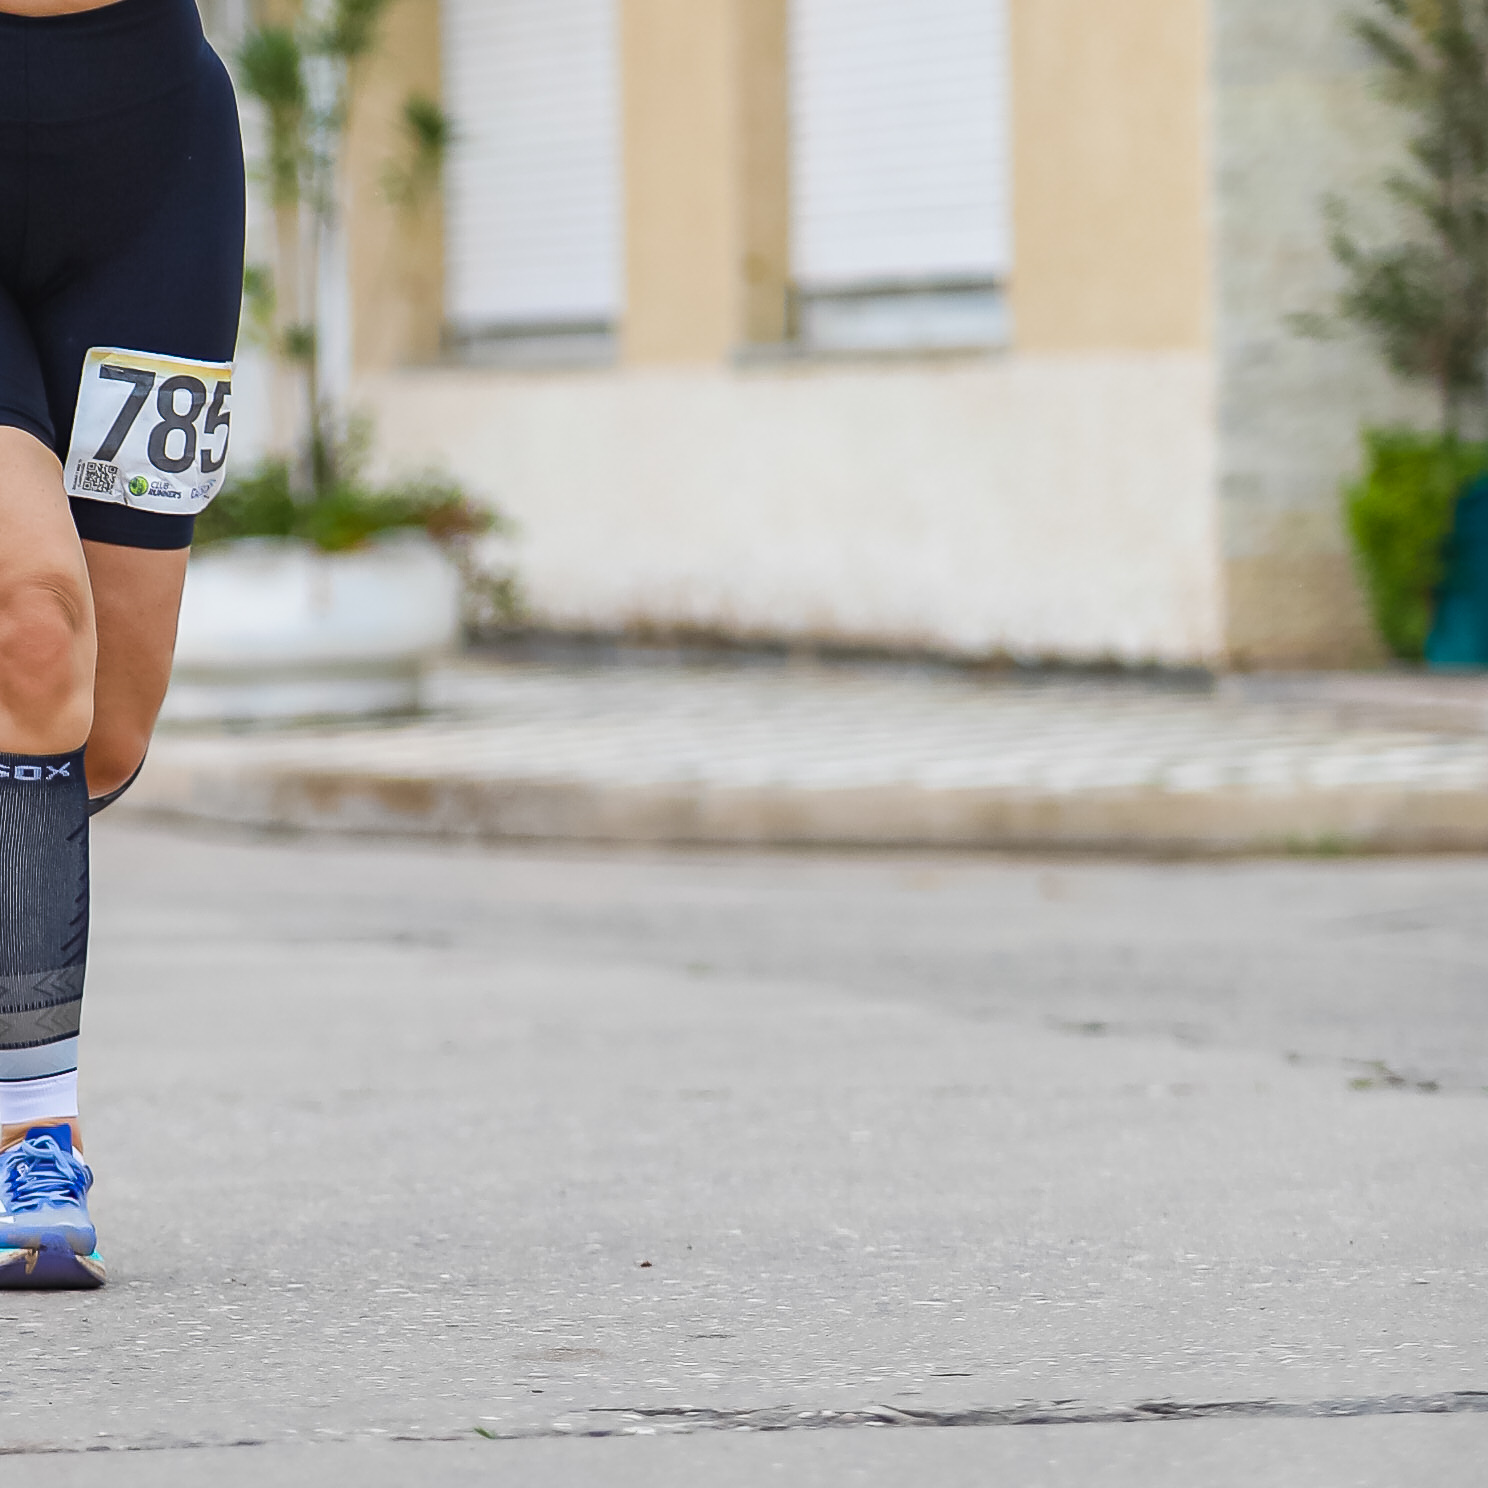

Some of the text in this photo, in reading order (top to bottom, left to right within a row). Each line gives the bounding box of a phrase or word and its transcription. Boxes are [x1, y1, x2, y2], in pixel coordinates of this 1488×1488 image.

[94, 364, 231, 473] 785
[150, 481, 170, 490] CLUB
[148, 487, 182, 499] RUNNERS
